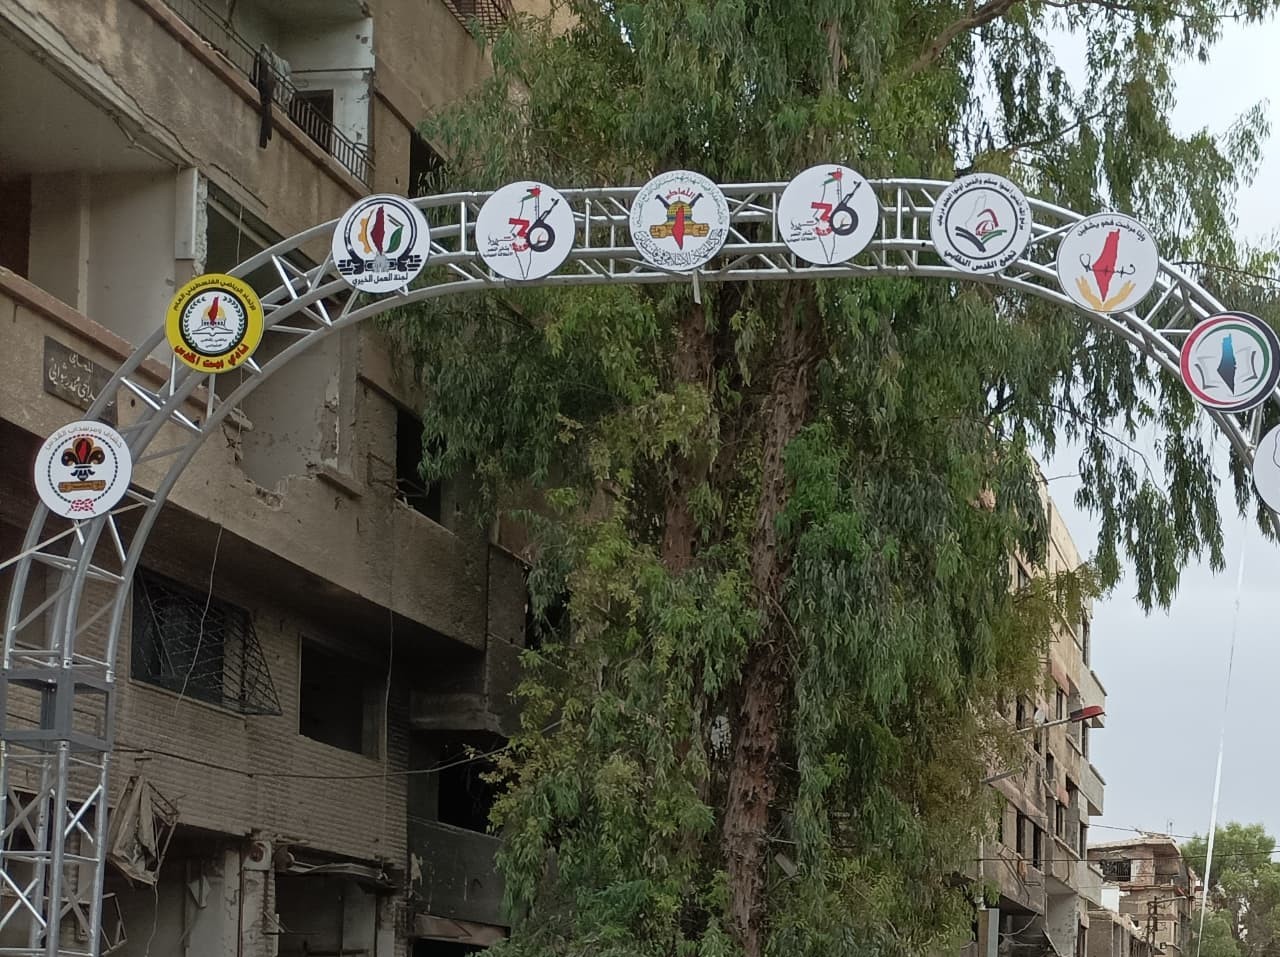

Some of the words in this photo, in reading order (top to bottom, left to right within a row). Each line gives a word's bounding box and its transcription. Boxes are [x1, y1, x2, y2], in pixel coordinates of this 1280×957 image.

[971, 260, 998, 271] القدس
[373, 272, 392, 284] العمل
[393, 272, 408, 281] لجنة
